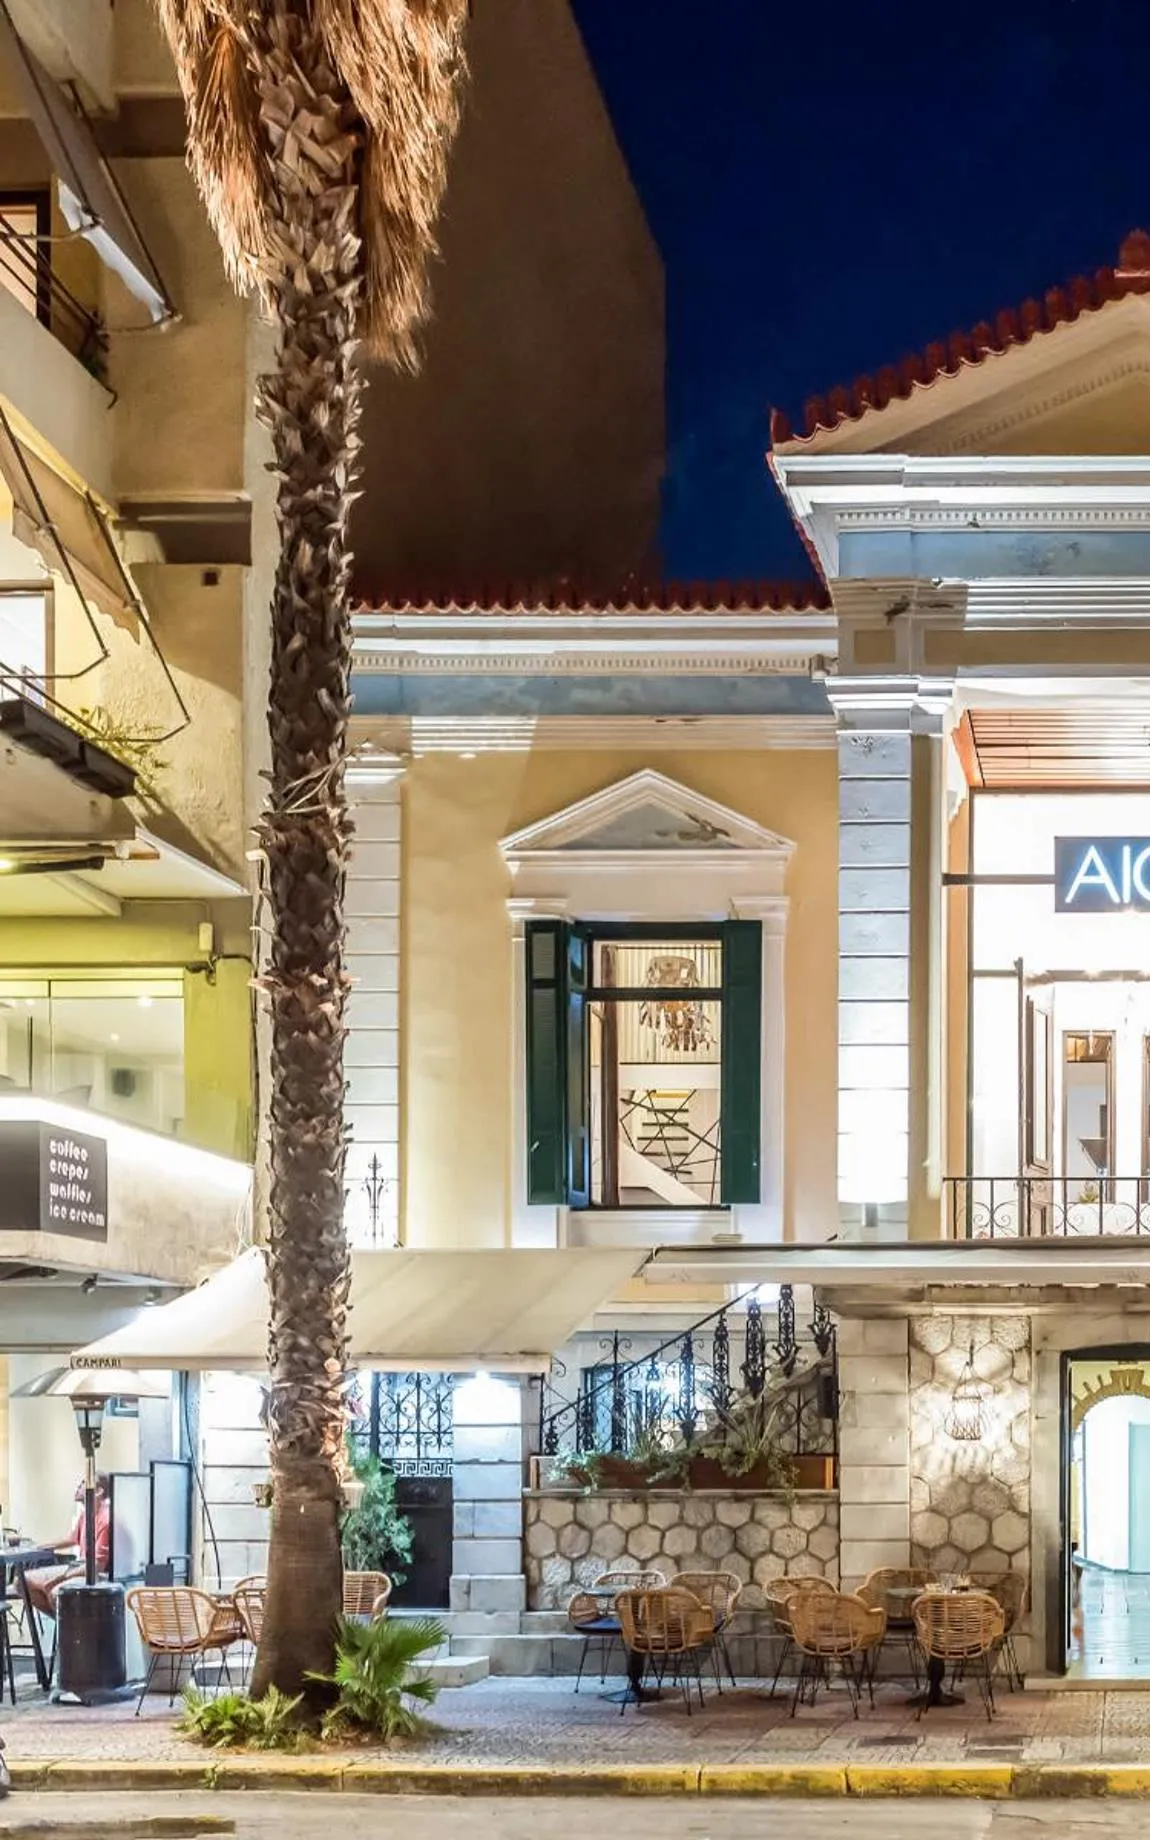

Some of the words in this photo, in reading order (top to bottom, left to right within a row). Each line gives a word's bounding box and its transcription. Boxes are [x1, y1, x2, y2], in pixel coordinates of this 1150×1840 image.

[49, 1140, 88, 1162] coffee
[49, 1159, 89, 1181] crepes
[49, 1182, 92, 1204] waffles
[49, 1197, 68, 1219] ice
[69, 1207, 105, 1227] cream
[76, 1358, 121, 1369] CAMPARI
